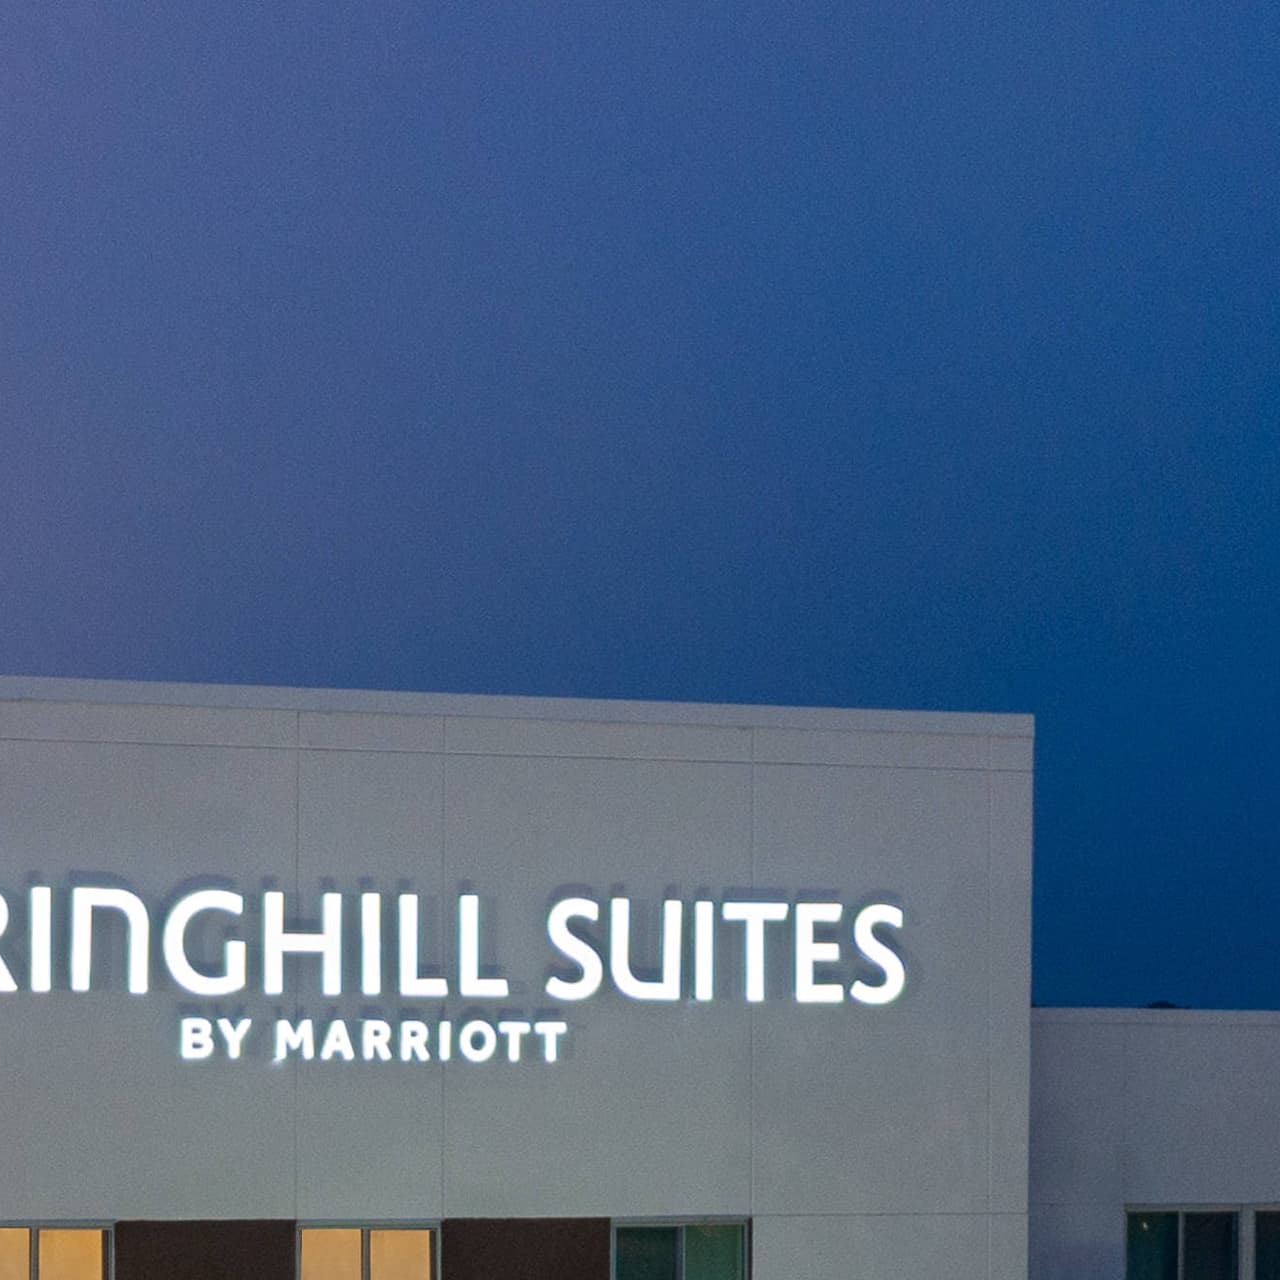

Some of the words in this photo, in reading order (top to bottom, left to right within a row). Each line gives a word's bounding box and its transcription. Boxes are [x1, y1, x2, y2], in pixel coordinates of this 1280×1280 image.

[543, 895, 908, 1007] SUITES
[178, 1015, 254, 1062] BY
[271, 1016, 569, 1065] MARRIOTT
